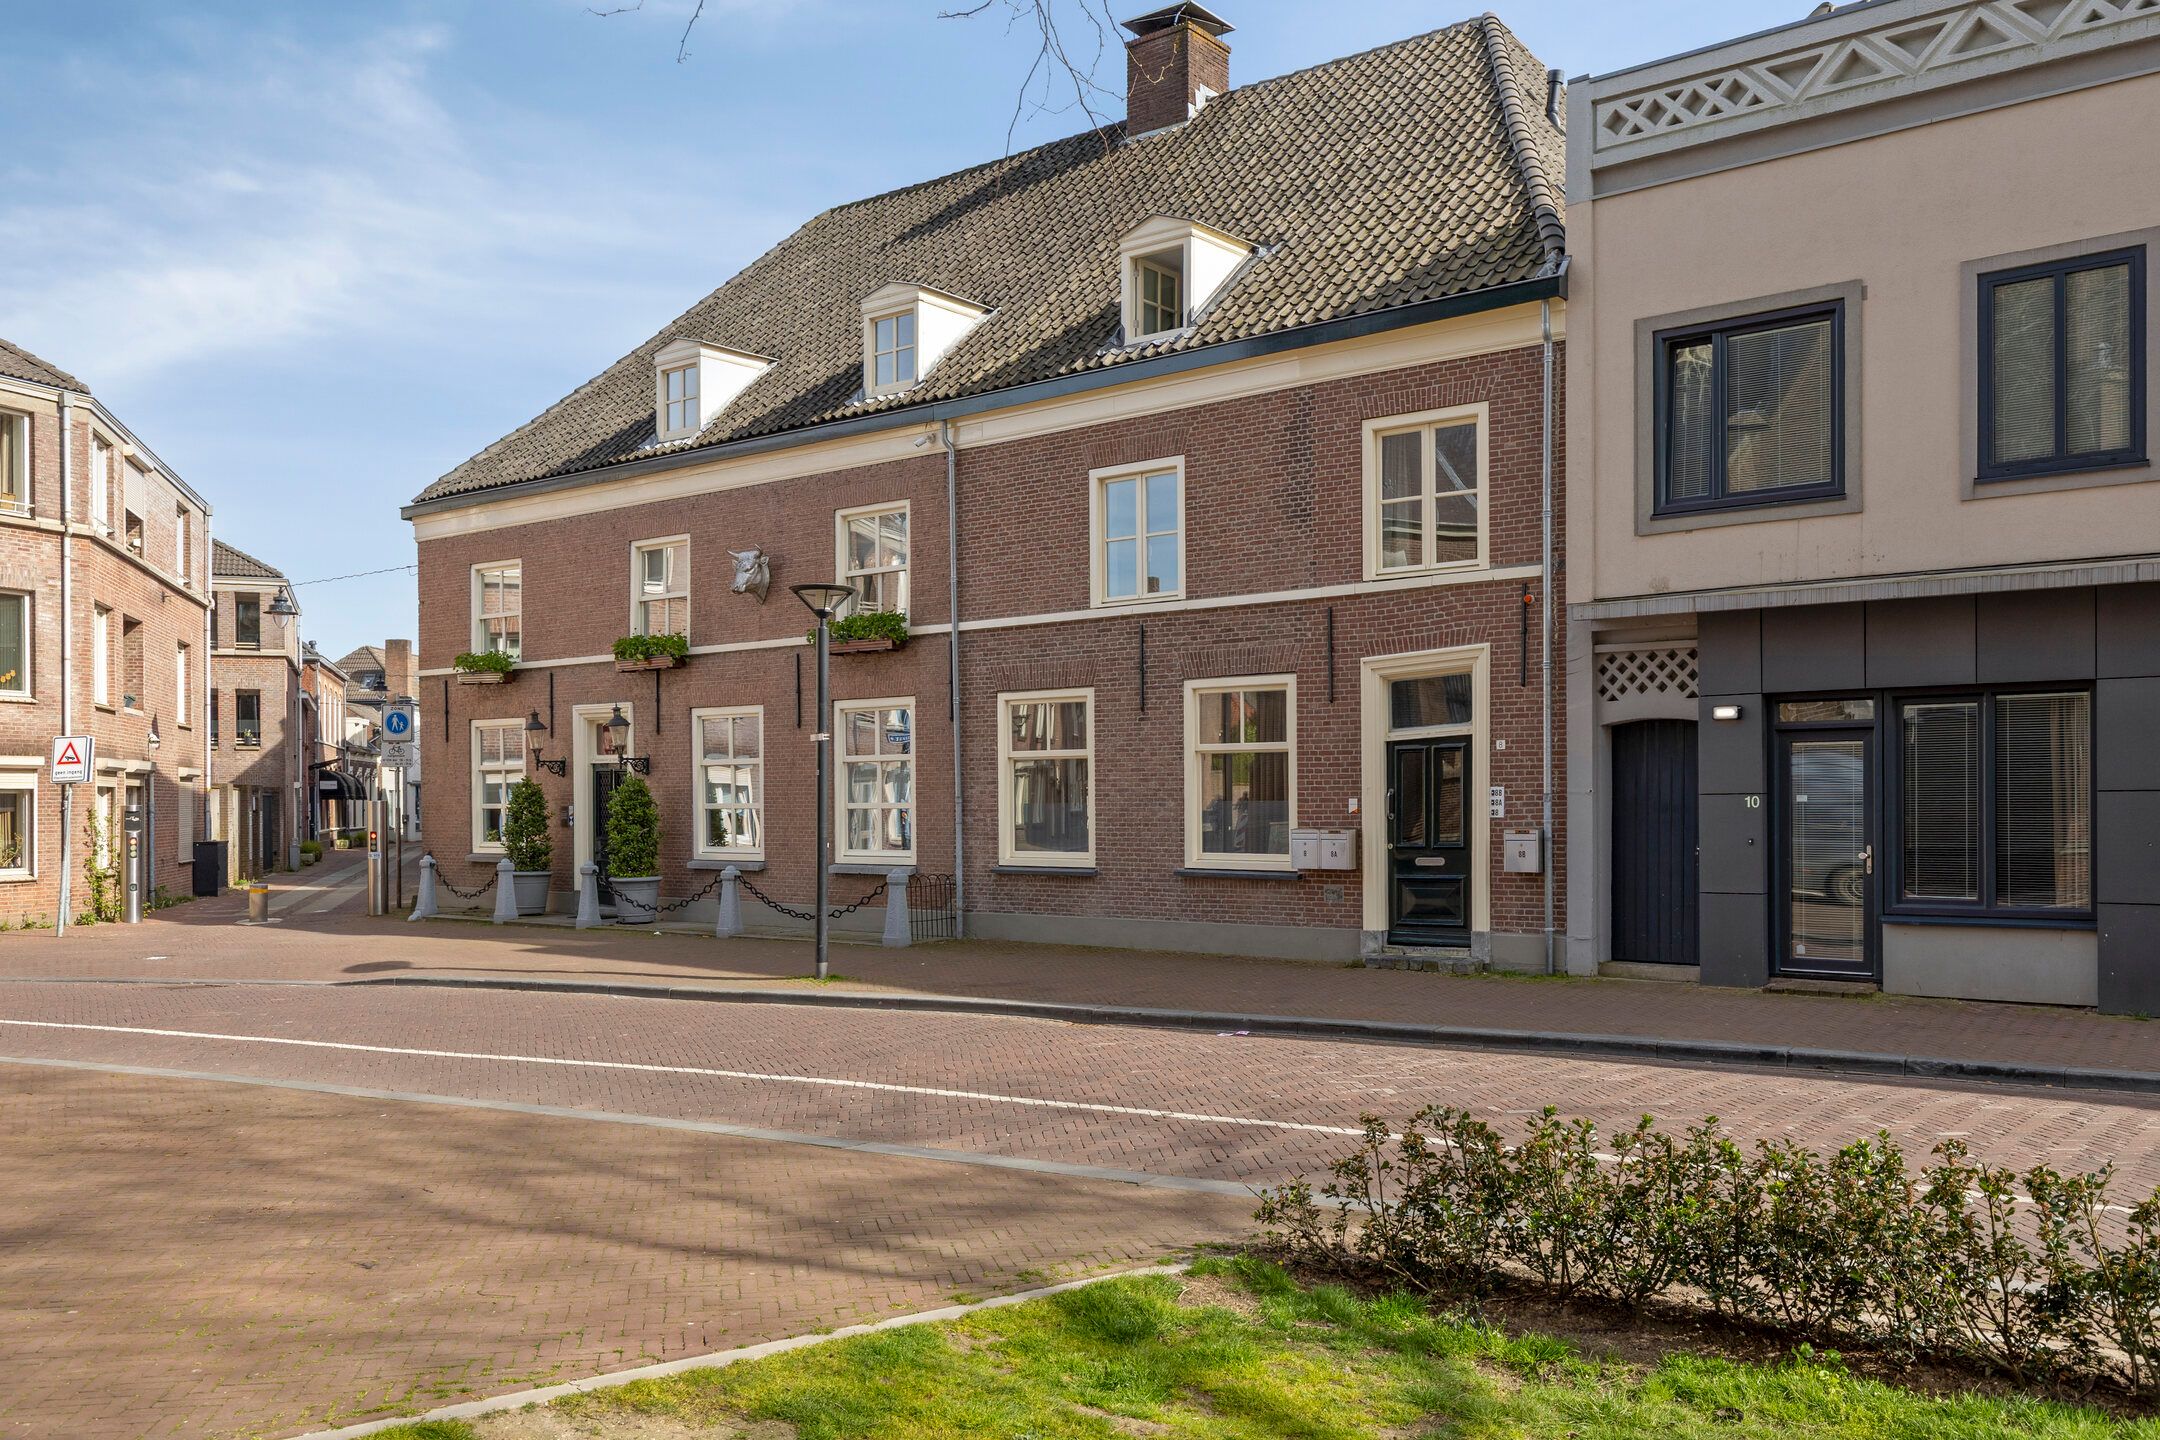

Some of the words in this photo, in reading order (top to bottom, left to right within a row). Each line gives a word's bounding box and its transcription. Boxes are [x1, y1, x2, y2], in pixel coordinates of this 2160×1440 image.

[1495, 789, 1503, 797] 8B
[1495, 799, 1503, 807] 8A
[1744, 795, 1760, 808] 10
[1330, 850, 1338, 858] 8A
[1518, 850, 1526, 858] 8B
